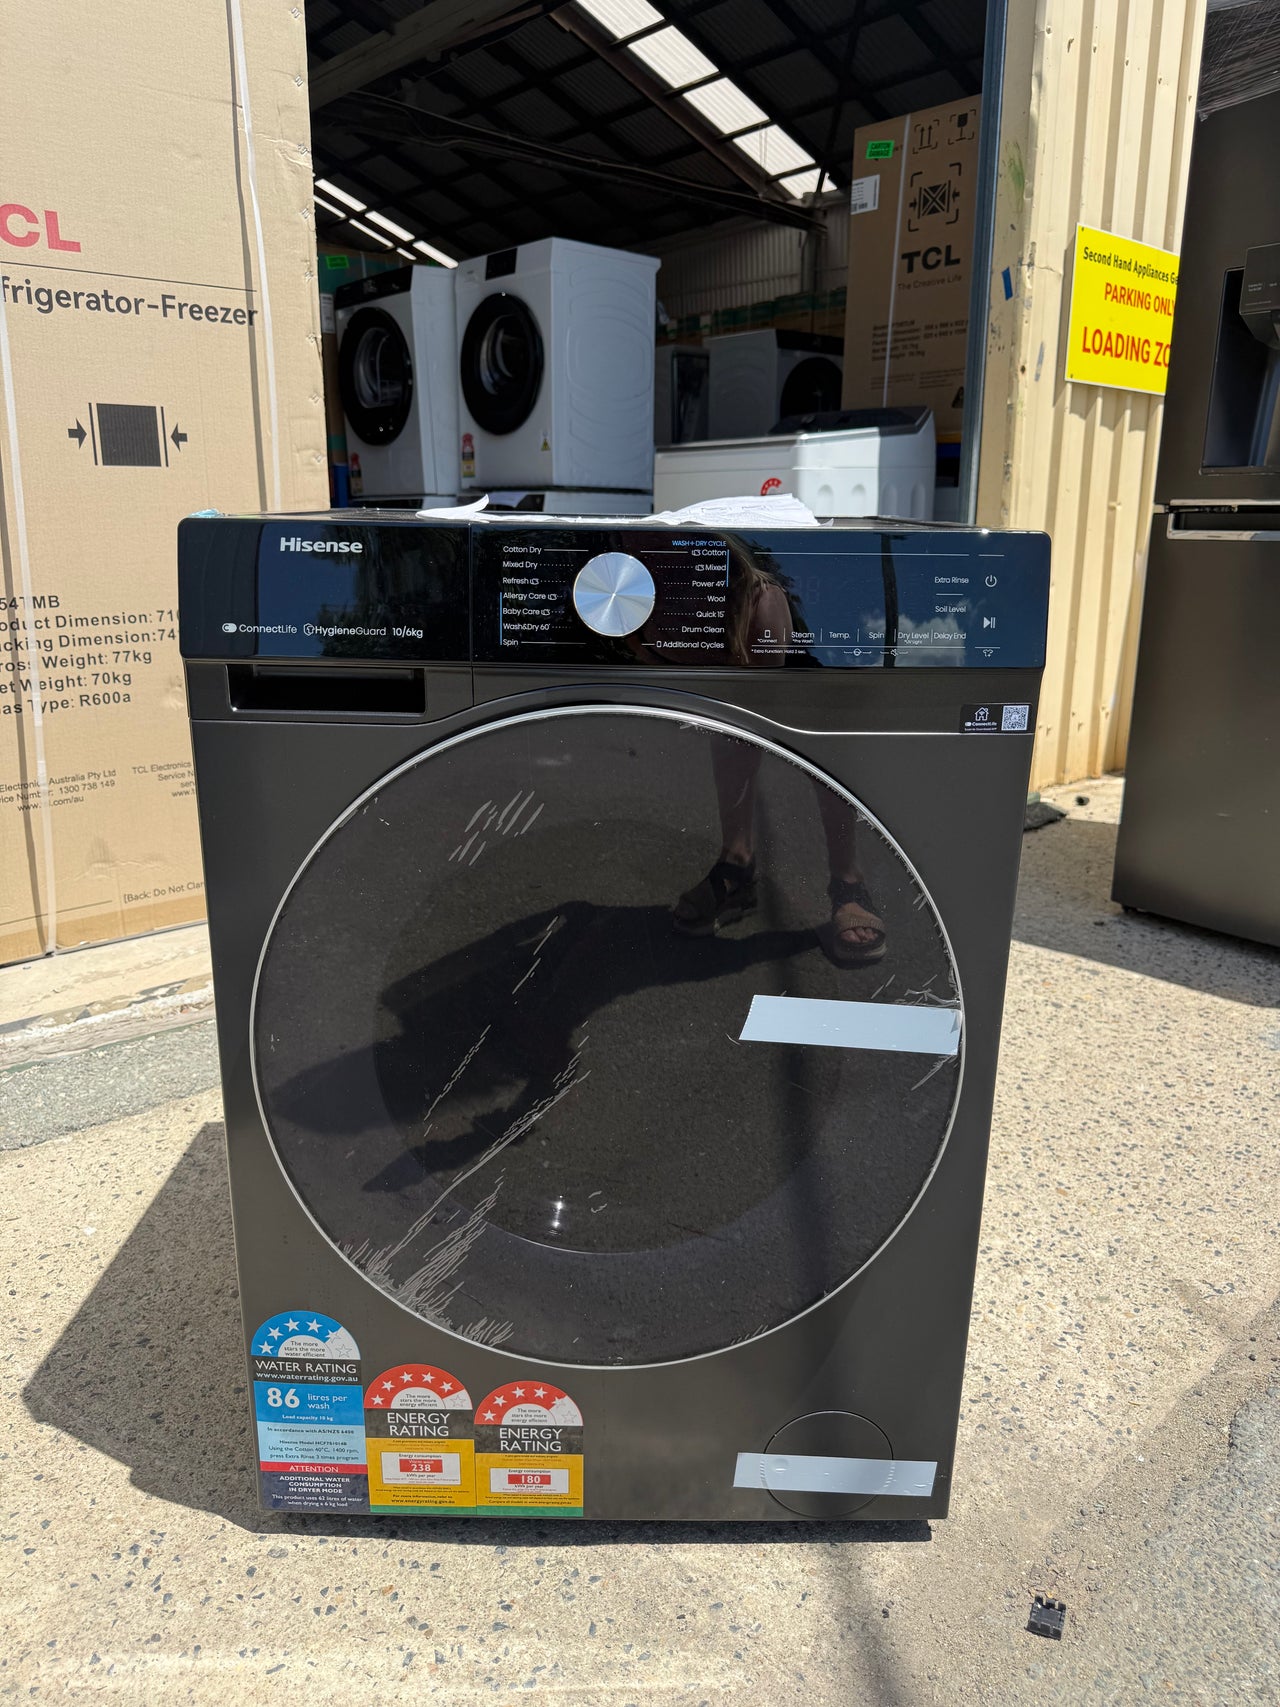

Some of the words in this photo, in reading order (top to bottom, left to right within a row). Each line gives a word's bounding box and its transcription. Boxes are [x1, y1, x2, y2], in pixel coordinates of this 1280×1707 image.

[901, 244, 961, 273] TCL
[1083, 246, 1112, 267] Second
[1113, 254, 1132, 272] Hand
[1133, 260, 1169, 282] Appliances
[1104, 282, 1151, 311] PARKING
[1082, 326, 1151, 364] LOADING
[280, 537, 363, 553] Hisense
[529, 546, 542, 554] Dry
[525, 561, 538, 569] Dry
[503, 592, 527, 600] Allergy
[503, 608, 521, 616] Baby
[935, 605, 947, 613] Soil
[56, 611, 153, 628] Dimension:
[156, 609, 179, 622] 71
[239, 624, 297, 634] ConnectLife
[315, 625, 387, 638] HygieneGuard
[392, 627, 424, 639] 10/6kg
[503, 623, 539, 631] Wash&Dry
[791, 631, 815, 639] Steam
[829, 632, 850, 640] Temp.
[869, 632, 884, 640] Spin
[0, 637, 53, 652] cking
[503, 639, 518, 647] Spin
[700, 641, 725, 649] Cycles
[42, 654, 108, 669] Weight:
[113, 650, 152, 664] 77kg
[20, 675, 87, 692] Weight:
[91, 672, 132, 686] 70kg
[79, 692, 131, 707] R600a
[132, 766, 149, 774] TCL
[151, 761, 192, 772] Electronics
[0, 780, 41, 792] Electronic
[48, 774, 85, 785] Australia
[87, 771, 102, 780] Pty
[103, 769, 116, 778] Ltd
[158, 771, 186, 781] Service
[59, 785, 80, 794] 1300
[82, 782, 97, 791] 738
[100, 779, 115, 788] 149
[18, 795, 84, 811] www..com/au
[153, 888, 167, 897] Do
[168, 884, 185, 894] Not
[255, 1360, 302, 1372] WATER
[305, 1363, 357, 1374] RATING
[256, 1372, 359, 1383] www.waterrating.gov.au
[267, 1387, 300, 1408] 86
[307, 1393, 330, 1402] litres
[387, 1412, 450, 1424] ENERGY
[389, 1425, 449, 1437] RATING
[500, 1428, 563, 1440] ENERGY
[500, 1441, 562, 1452] RATING
[289, 1465, 339, 1473] ATTENTION
[411, 1464, 431, 1472] 238
[521, 1475, 540, 1483] 180
